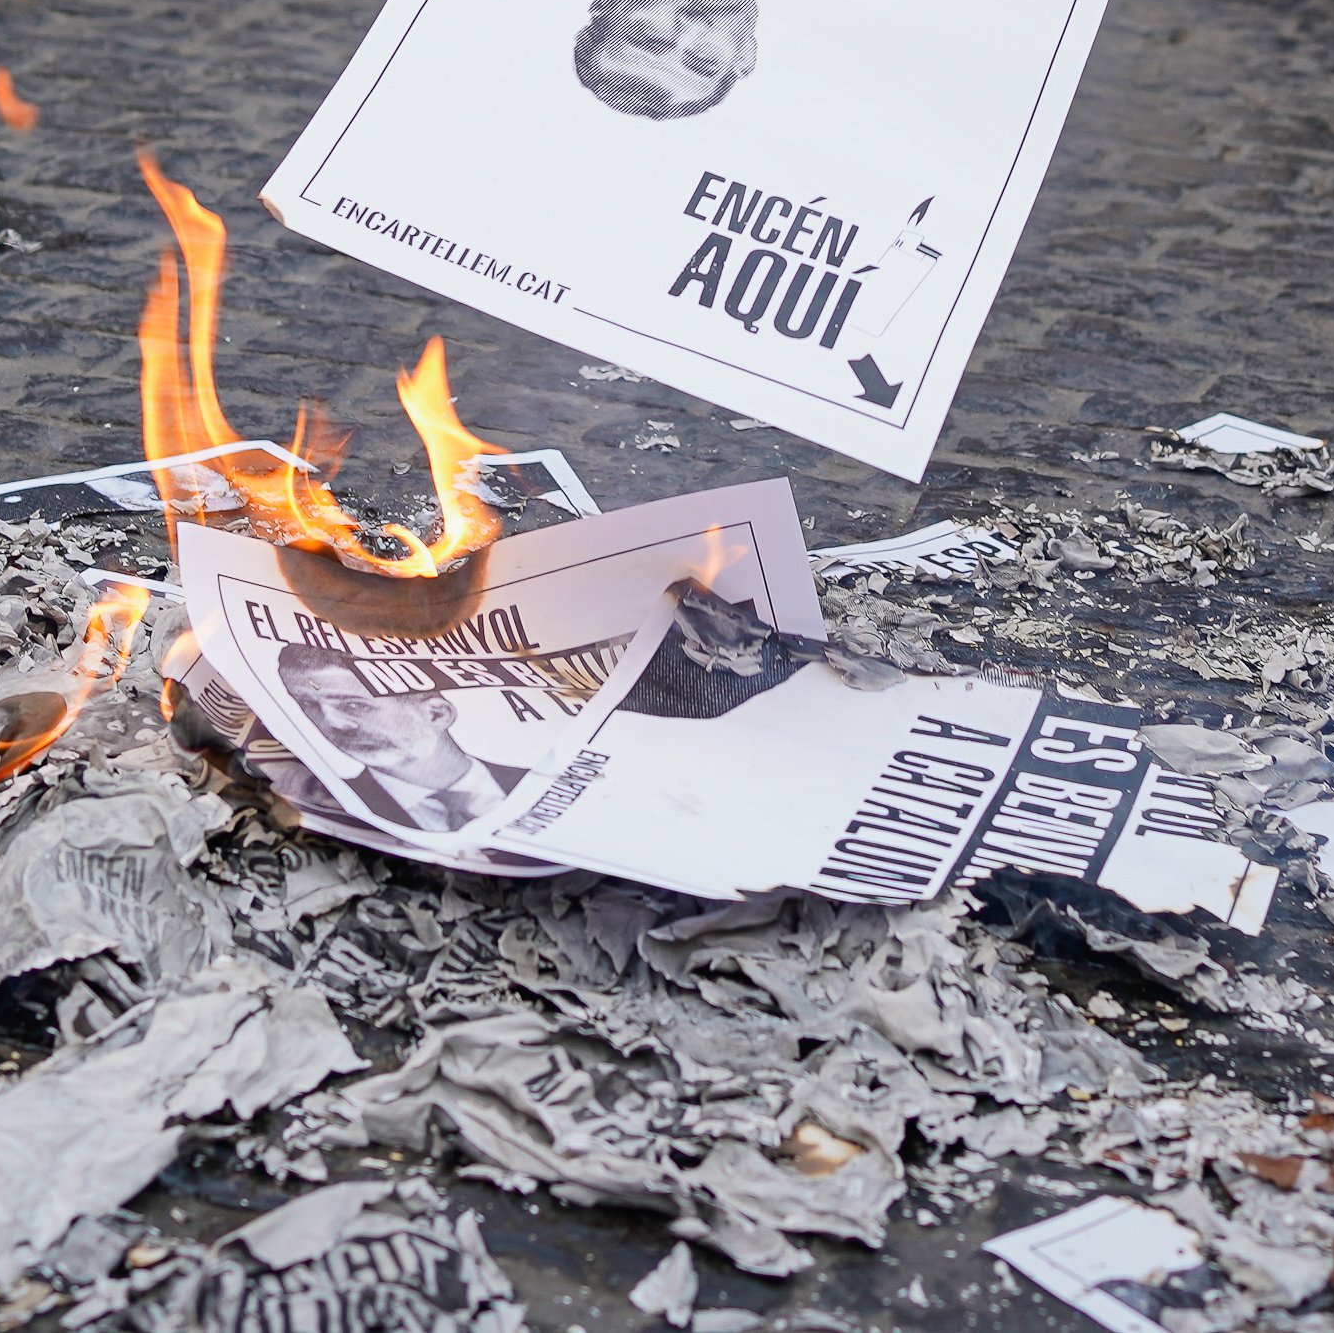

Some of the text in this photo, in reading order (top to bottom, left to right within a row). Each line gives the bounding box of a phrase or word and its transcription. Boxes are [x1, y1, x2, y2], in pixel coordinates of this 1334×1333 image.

[683, 170, 860, 269] ENCÉN
[331, 196, 572, 307] ENCARTELLEM.CAT
[668, 233, 881, 350] AQUÍ
[245, 600, 289, 643] EL
[353, 659, 436, 696] NO
[500, 689, 546, 722] A
[910, 714, 1012, 748] A
